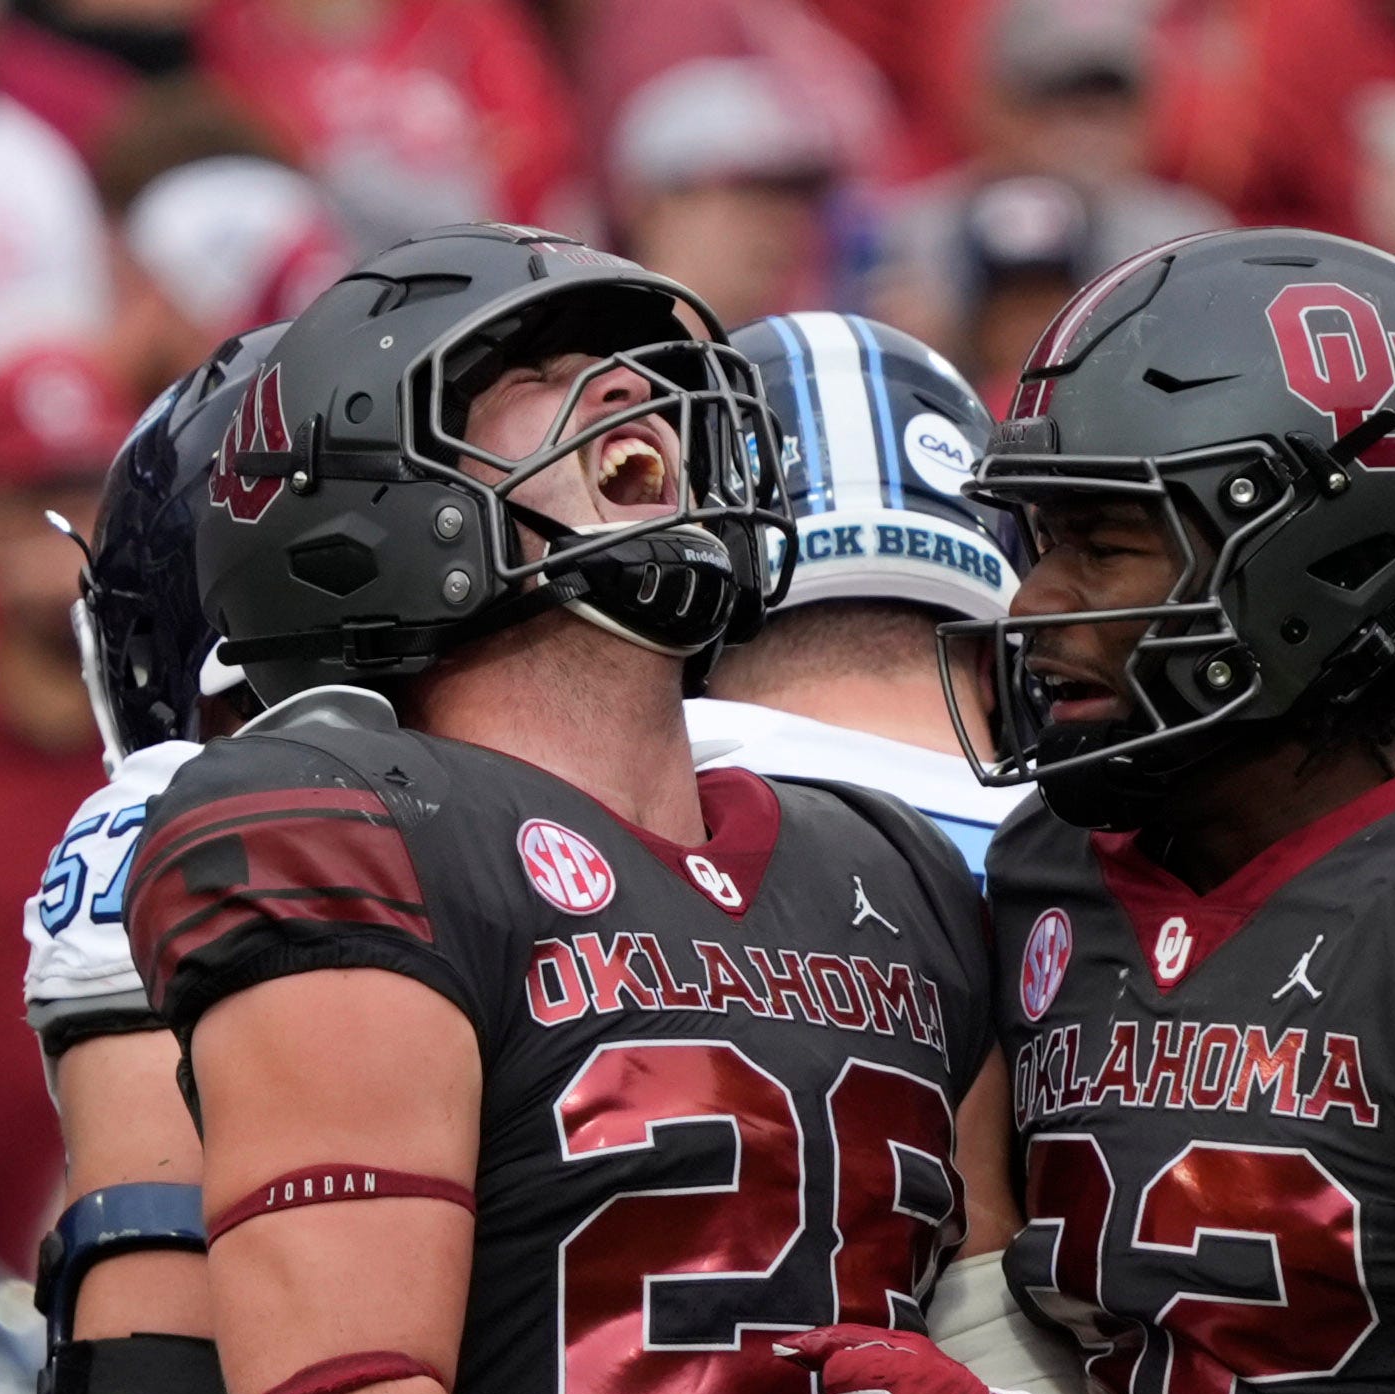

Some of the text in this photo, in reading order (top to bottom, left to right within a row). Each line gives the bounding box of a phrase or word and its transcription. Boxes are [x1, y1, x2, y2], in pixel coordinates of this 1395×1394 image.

[918, 432, 965, 467] CAA
[874, 525, 1003, 589] BEARS
[39, 801, 147, 939] 57
[523, 823, 607, 908] SEC
[685, 854, 743, 907] OU
[1024, 915, 1070, 1014] SEC
[1154, 916, 1194, 980] OU
[1014, 1020, 1380, 1132] OKLAHOMA
[266, 1171, 377, 1206] JORDAN
